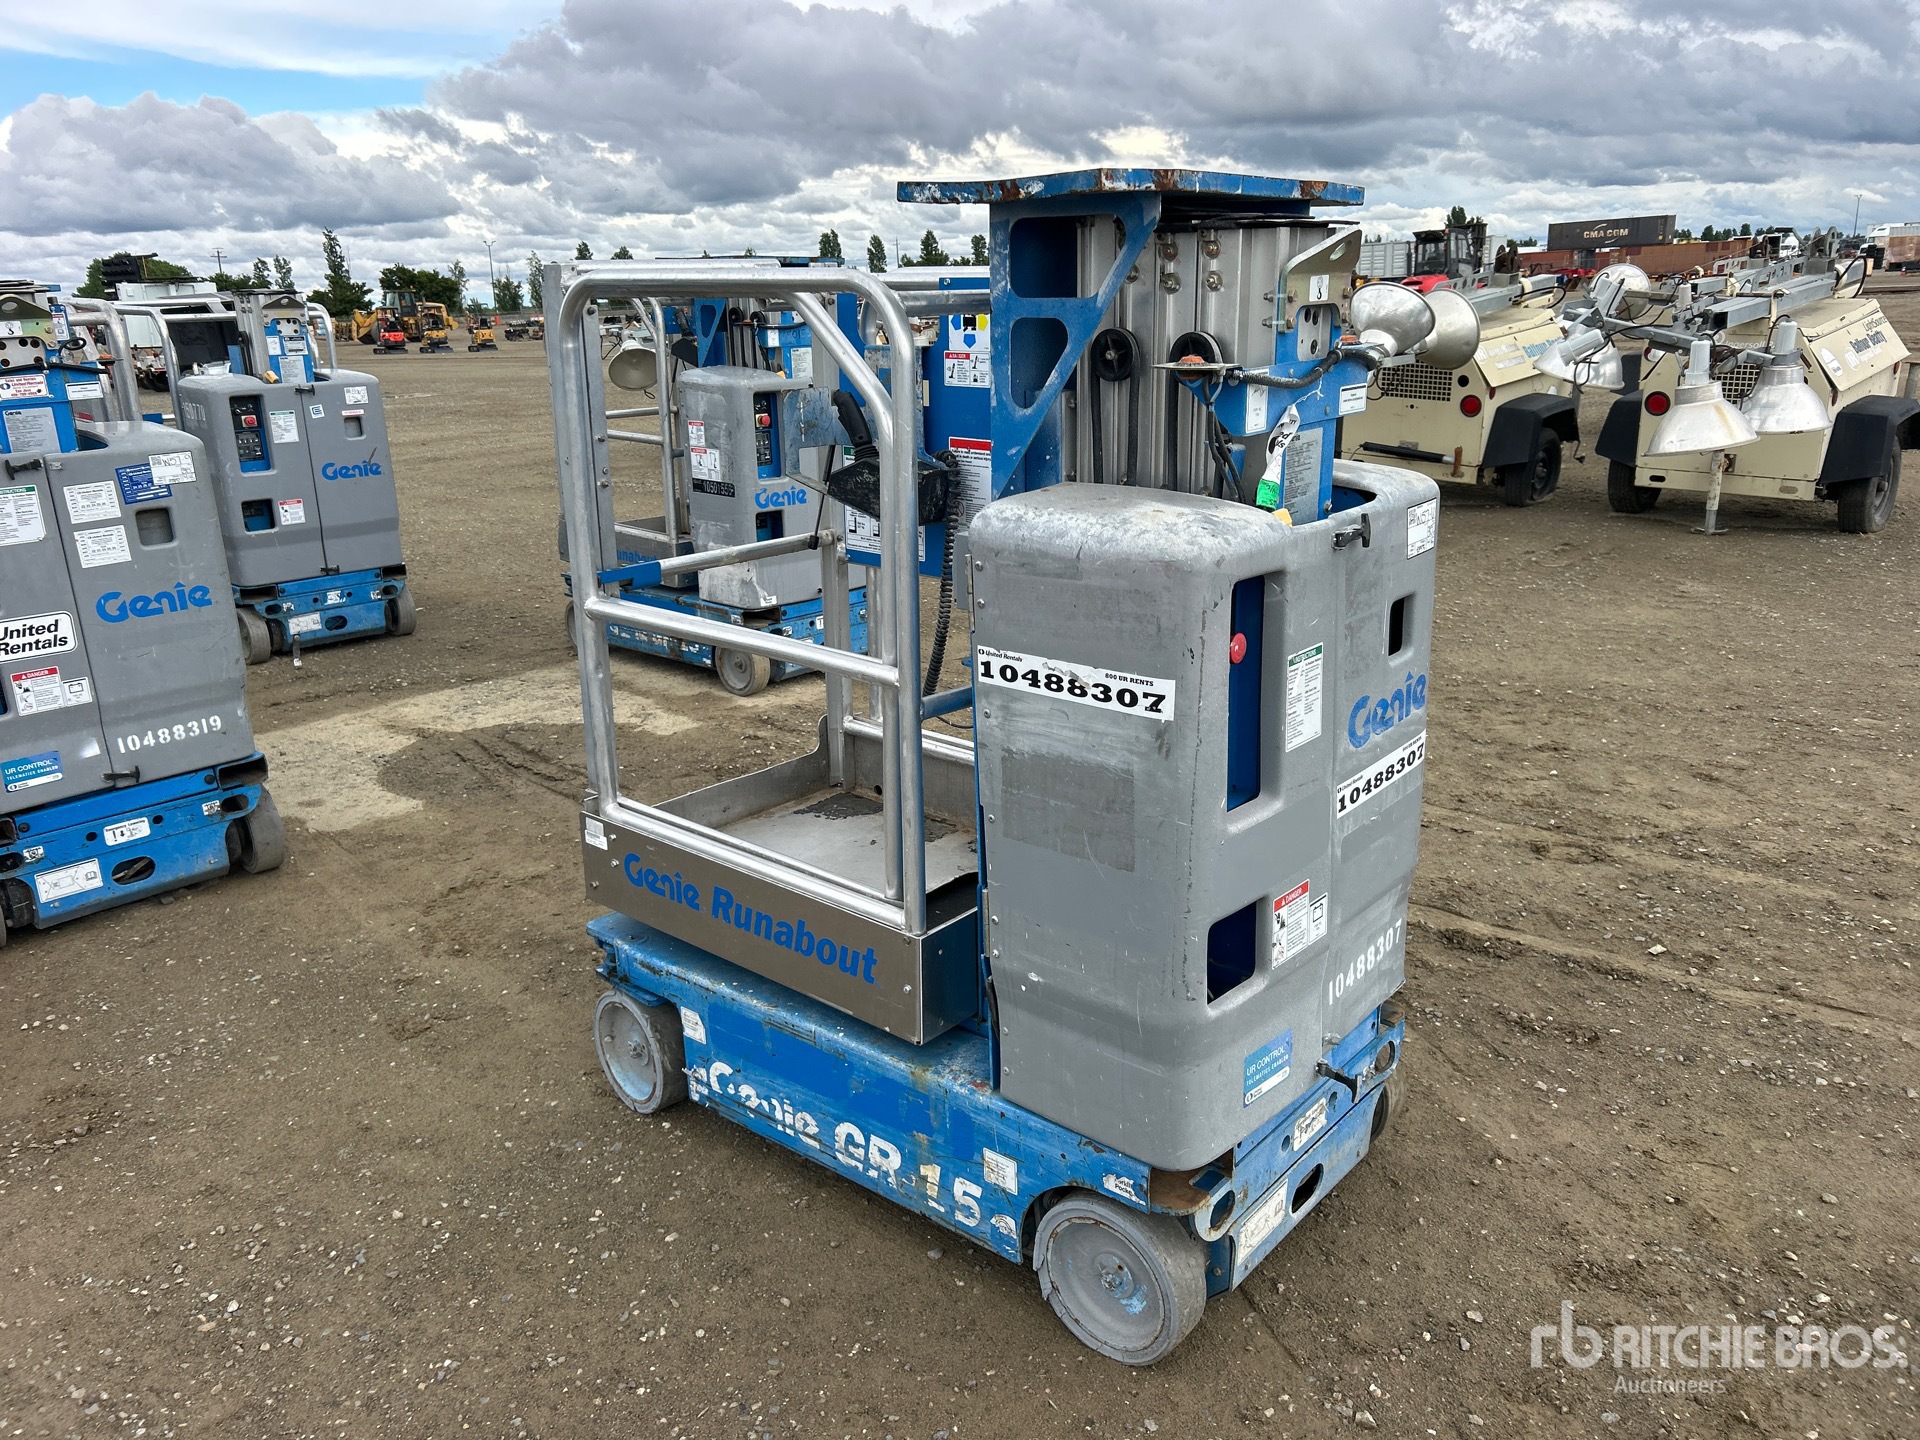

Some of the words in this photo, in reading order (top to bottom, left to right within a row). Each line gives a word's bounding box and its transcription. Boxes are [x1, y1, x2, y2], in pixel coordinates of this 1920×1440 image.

[1583, 230, 1605, 239] CMA
[1862, 316, 1887, 332] LightSource
[1849, 338, 1871, 354] Balfour
[321, 460, 382, 481] Genie
[754, 485, 807, 509] Genie
[96, 581, 213, 623] Genie
[0, 634, 68, 656] Rentals
[985, 650, 1002, 659] United
[1003, 653, 1023, 663] Rentals
[26, 669, 49, 679] DANGER
[1104, 672, 1118, 680] 800
[1118, 674, 1129, 683] UR
[1129, 676, 1154, 687] RENTS
[980, 660, 1167, 714] 10488307
[1347, 671, 1427, 749] Genie
[116, 714, 223, 754] 10488319
[5, 767, 17, 775] UR
[17, 759, 53, 772] CONTROL
[1337, 741, 1425, 814] 10488307
[623, 852, 700, 912] Genie
[1285, 887, 1303, 903] DANGER
[711, 886, 879, 985] Runabout
[1328, 918, 1402, 1006] 10488307
[1246, 1063, 1256, 1076] UR
[1256, 1045, 1286, 1069] CONTROL
